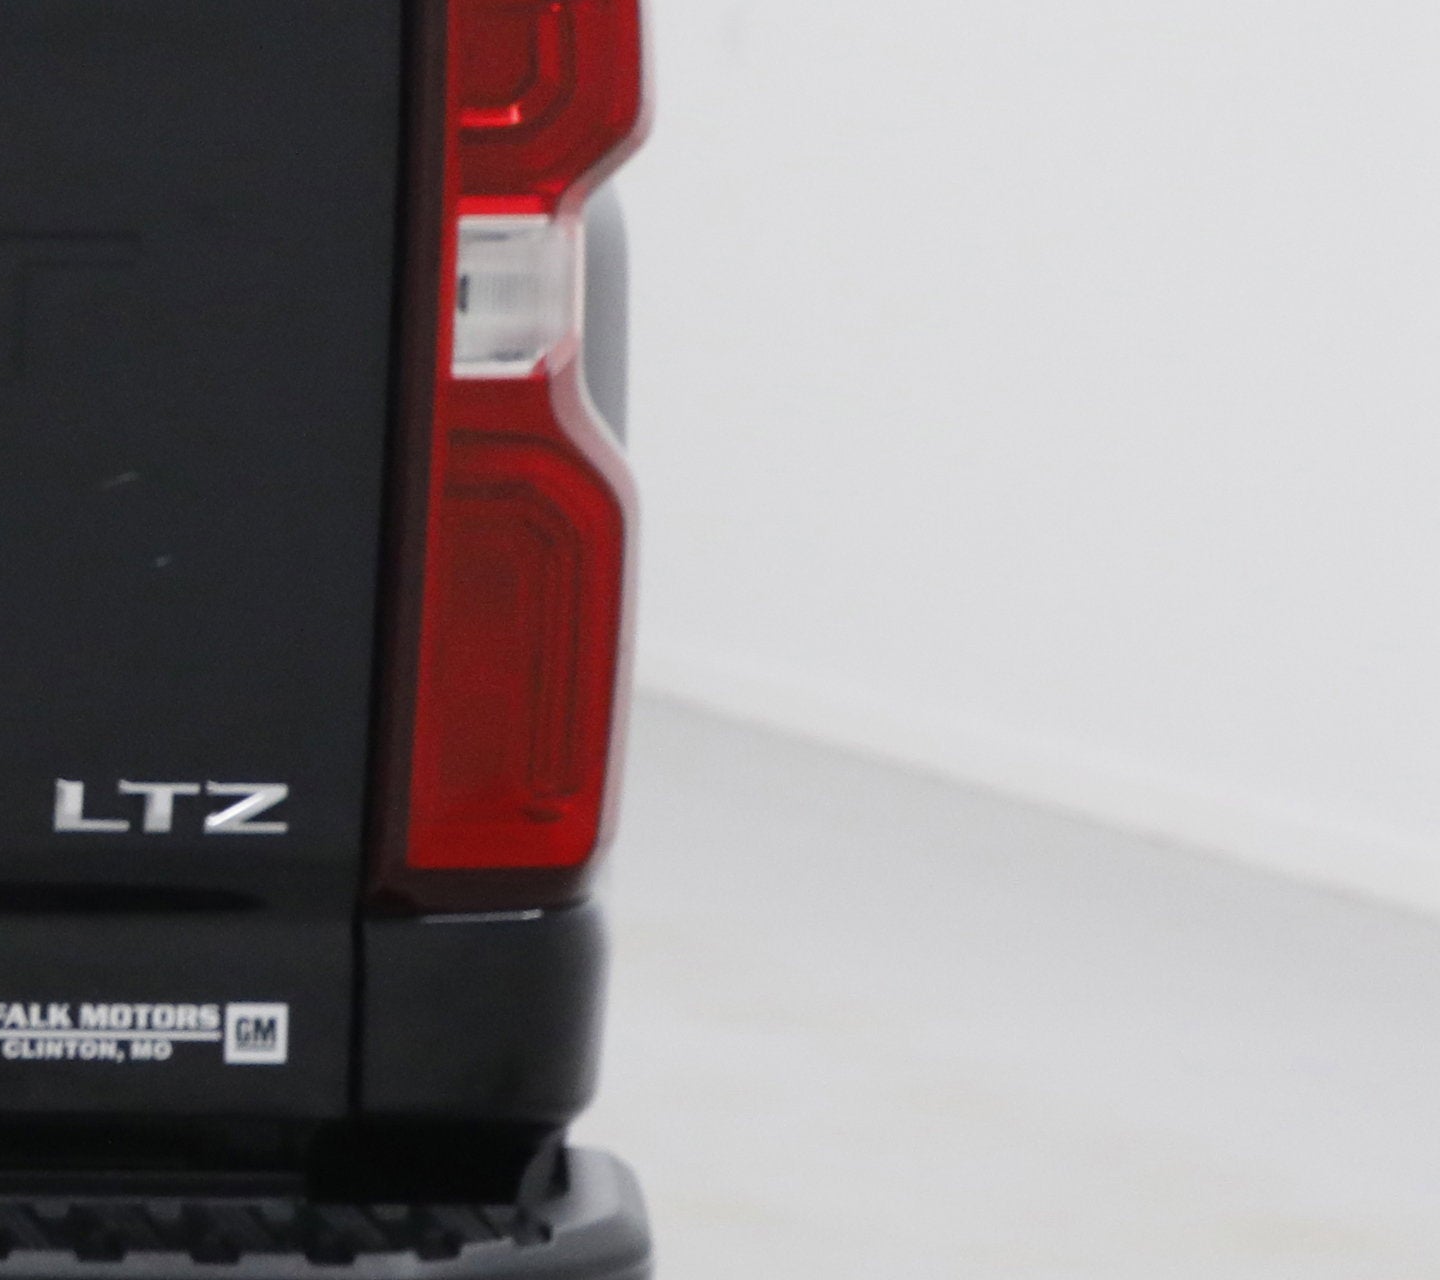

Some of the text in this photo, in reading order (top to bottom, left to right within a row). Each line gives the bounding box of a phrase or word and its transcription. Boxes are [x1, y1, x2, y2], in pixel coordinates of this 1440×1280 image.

[53, 778, 290, 835] LTZ
[79, 1002, 221, 1030] MOTORS
[235, 1016, 278, 1050] GM
[1, 1038, 174, 1063] CLINTON, MO
